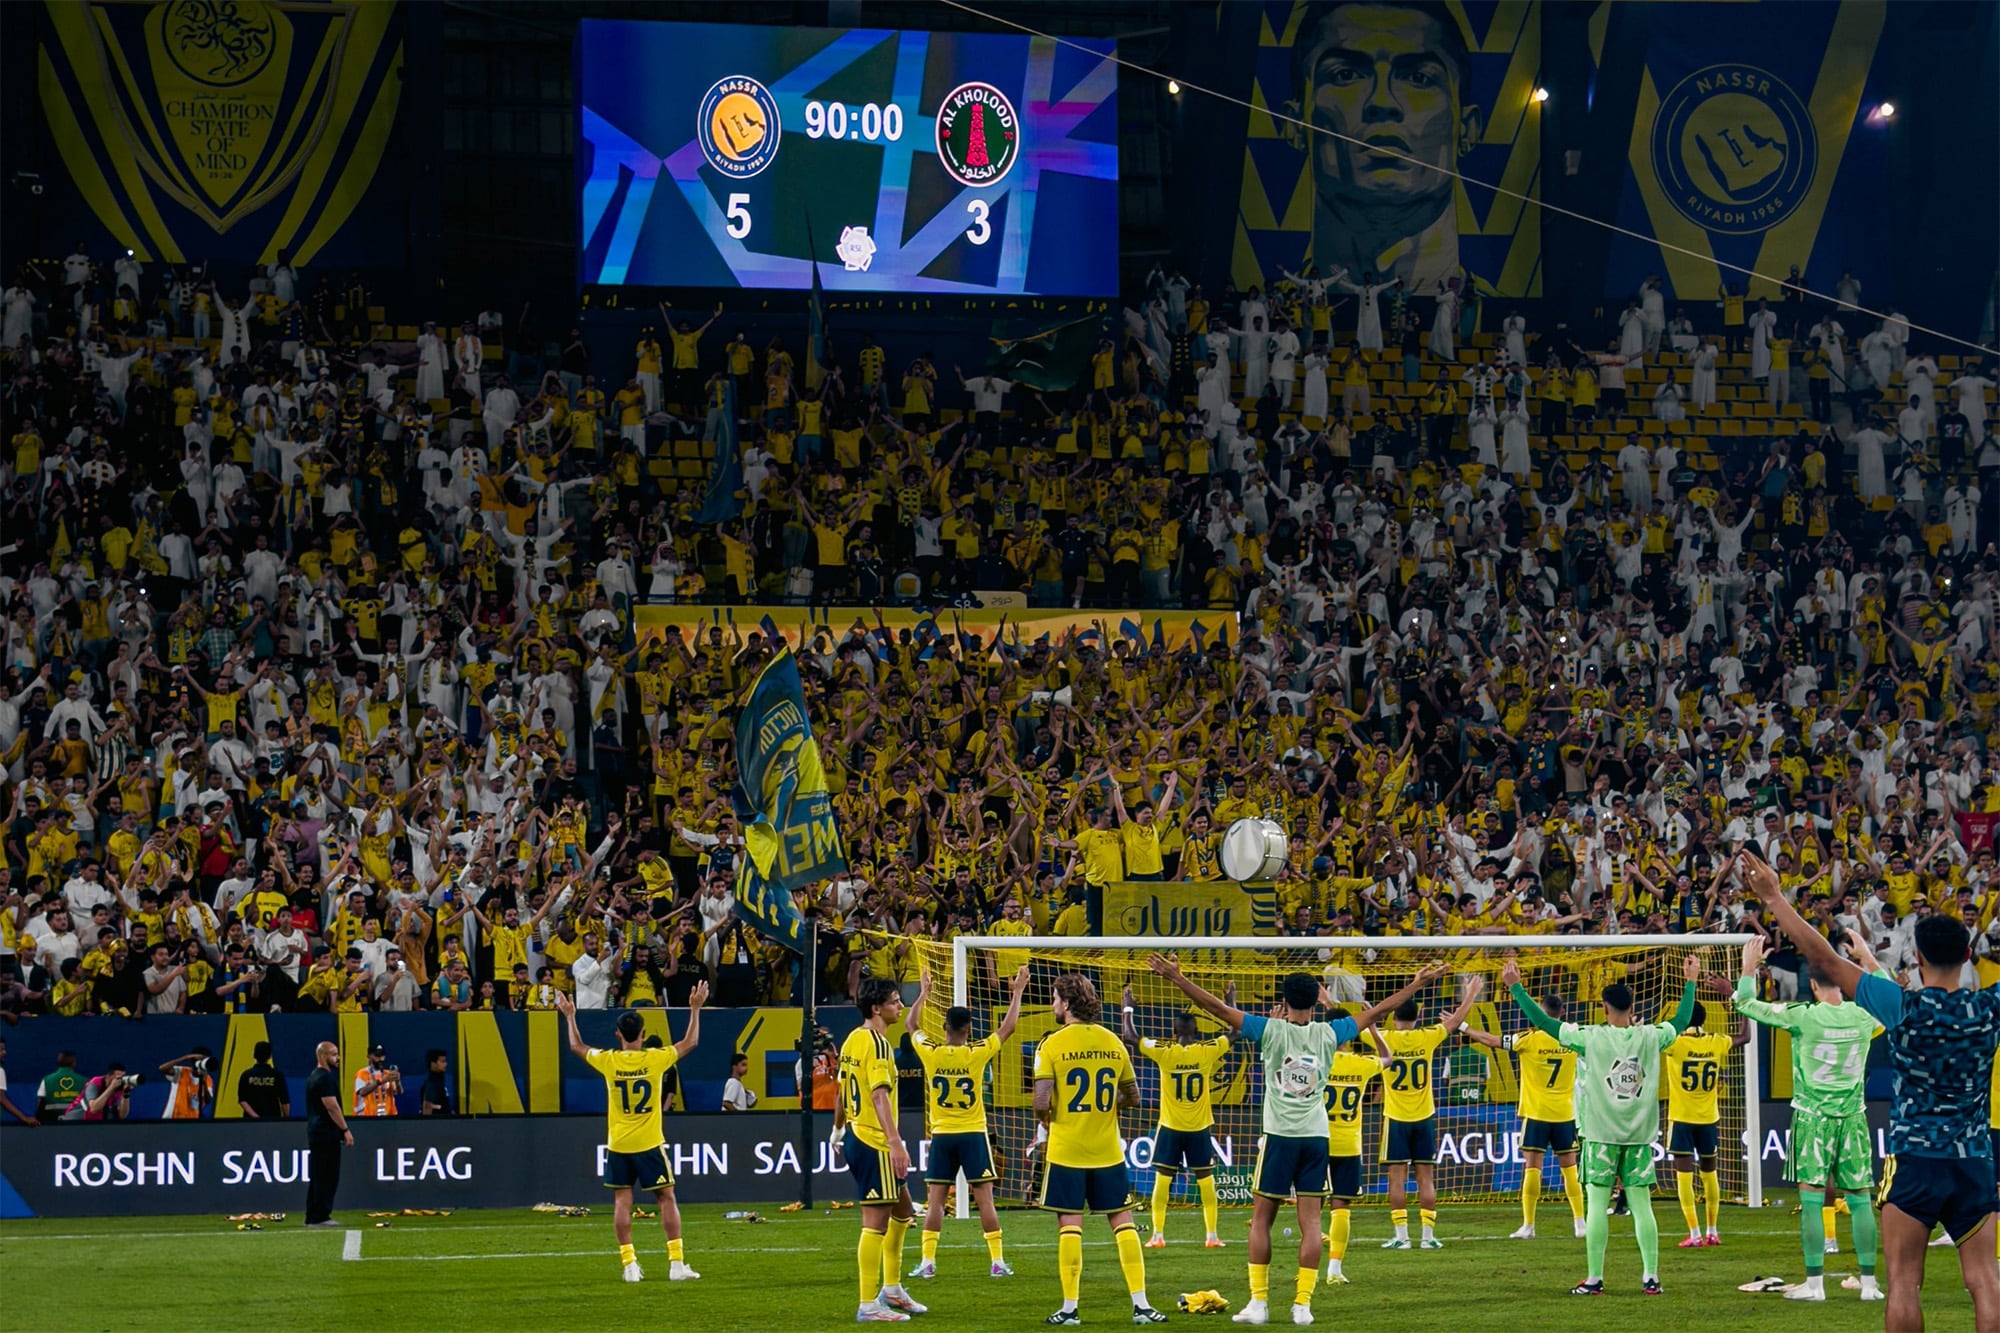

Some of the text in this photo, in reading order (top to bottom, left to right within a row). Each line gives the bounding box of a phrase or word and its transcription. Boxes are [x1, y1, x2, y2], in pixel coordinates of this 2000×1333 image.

[719, 80, 759, 96] NASSR
[1696, 72, 1771, 96] NASSR
[166, 101, 274, 119] CHAMPION
[805, 101, 903, 141] 90:00
[943, 88, 1013, 128] AL KHOLOOD
[190, 120, 251, 137] STATE
[207, 136, 235, 153] OF
[196, 152, 248, 170] MIND
[714, 153, 746, 172] RIYADH
[959, 164, 996, 180] الخلود
[726, 193, 752, 240] 5
[966, 199, 992, 246] 3
[1688, 195, 1745, 224] RIYADH
[936, 1067, 970, 1076] AYMAN
[1390, 1059, 1428, 1091] 20
[1546, 1058, 1562, 1088] 7
[1681, 1060, 1718, 1092] 56
[1813, 1043, 1862, 1083] 24
[248, 1077, 275, 1087] POLICE
[1066, 1067, 1116, 1113] 26
[1171, 1072, 1204, 1103] 10
[1291, 1073, 1309, 1085] RSL
[1621, 1073, 1638, 1084] RSL
[615, 1079, 653, 1114] 12
[932, 1077, 976, 1110] 23
[54, 1150, 195, 1187] ROSHN
